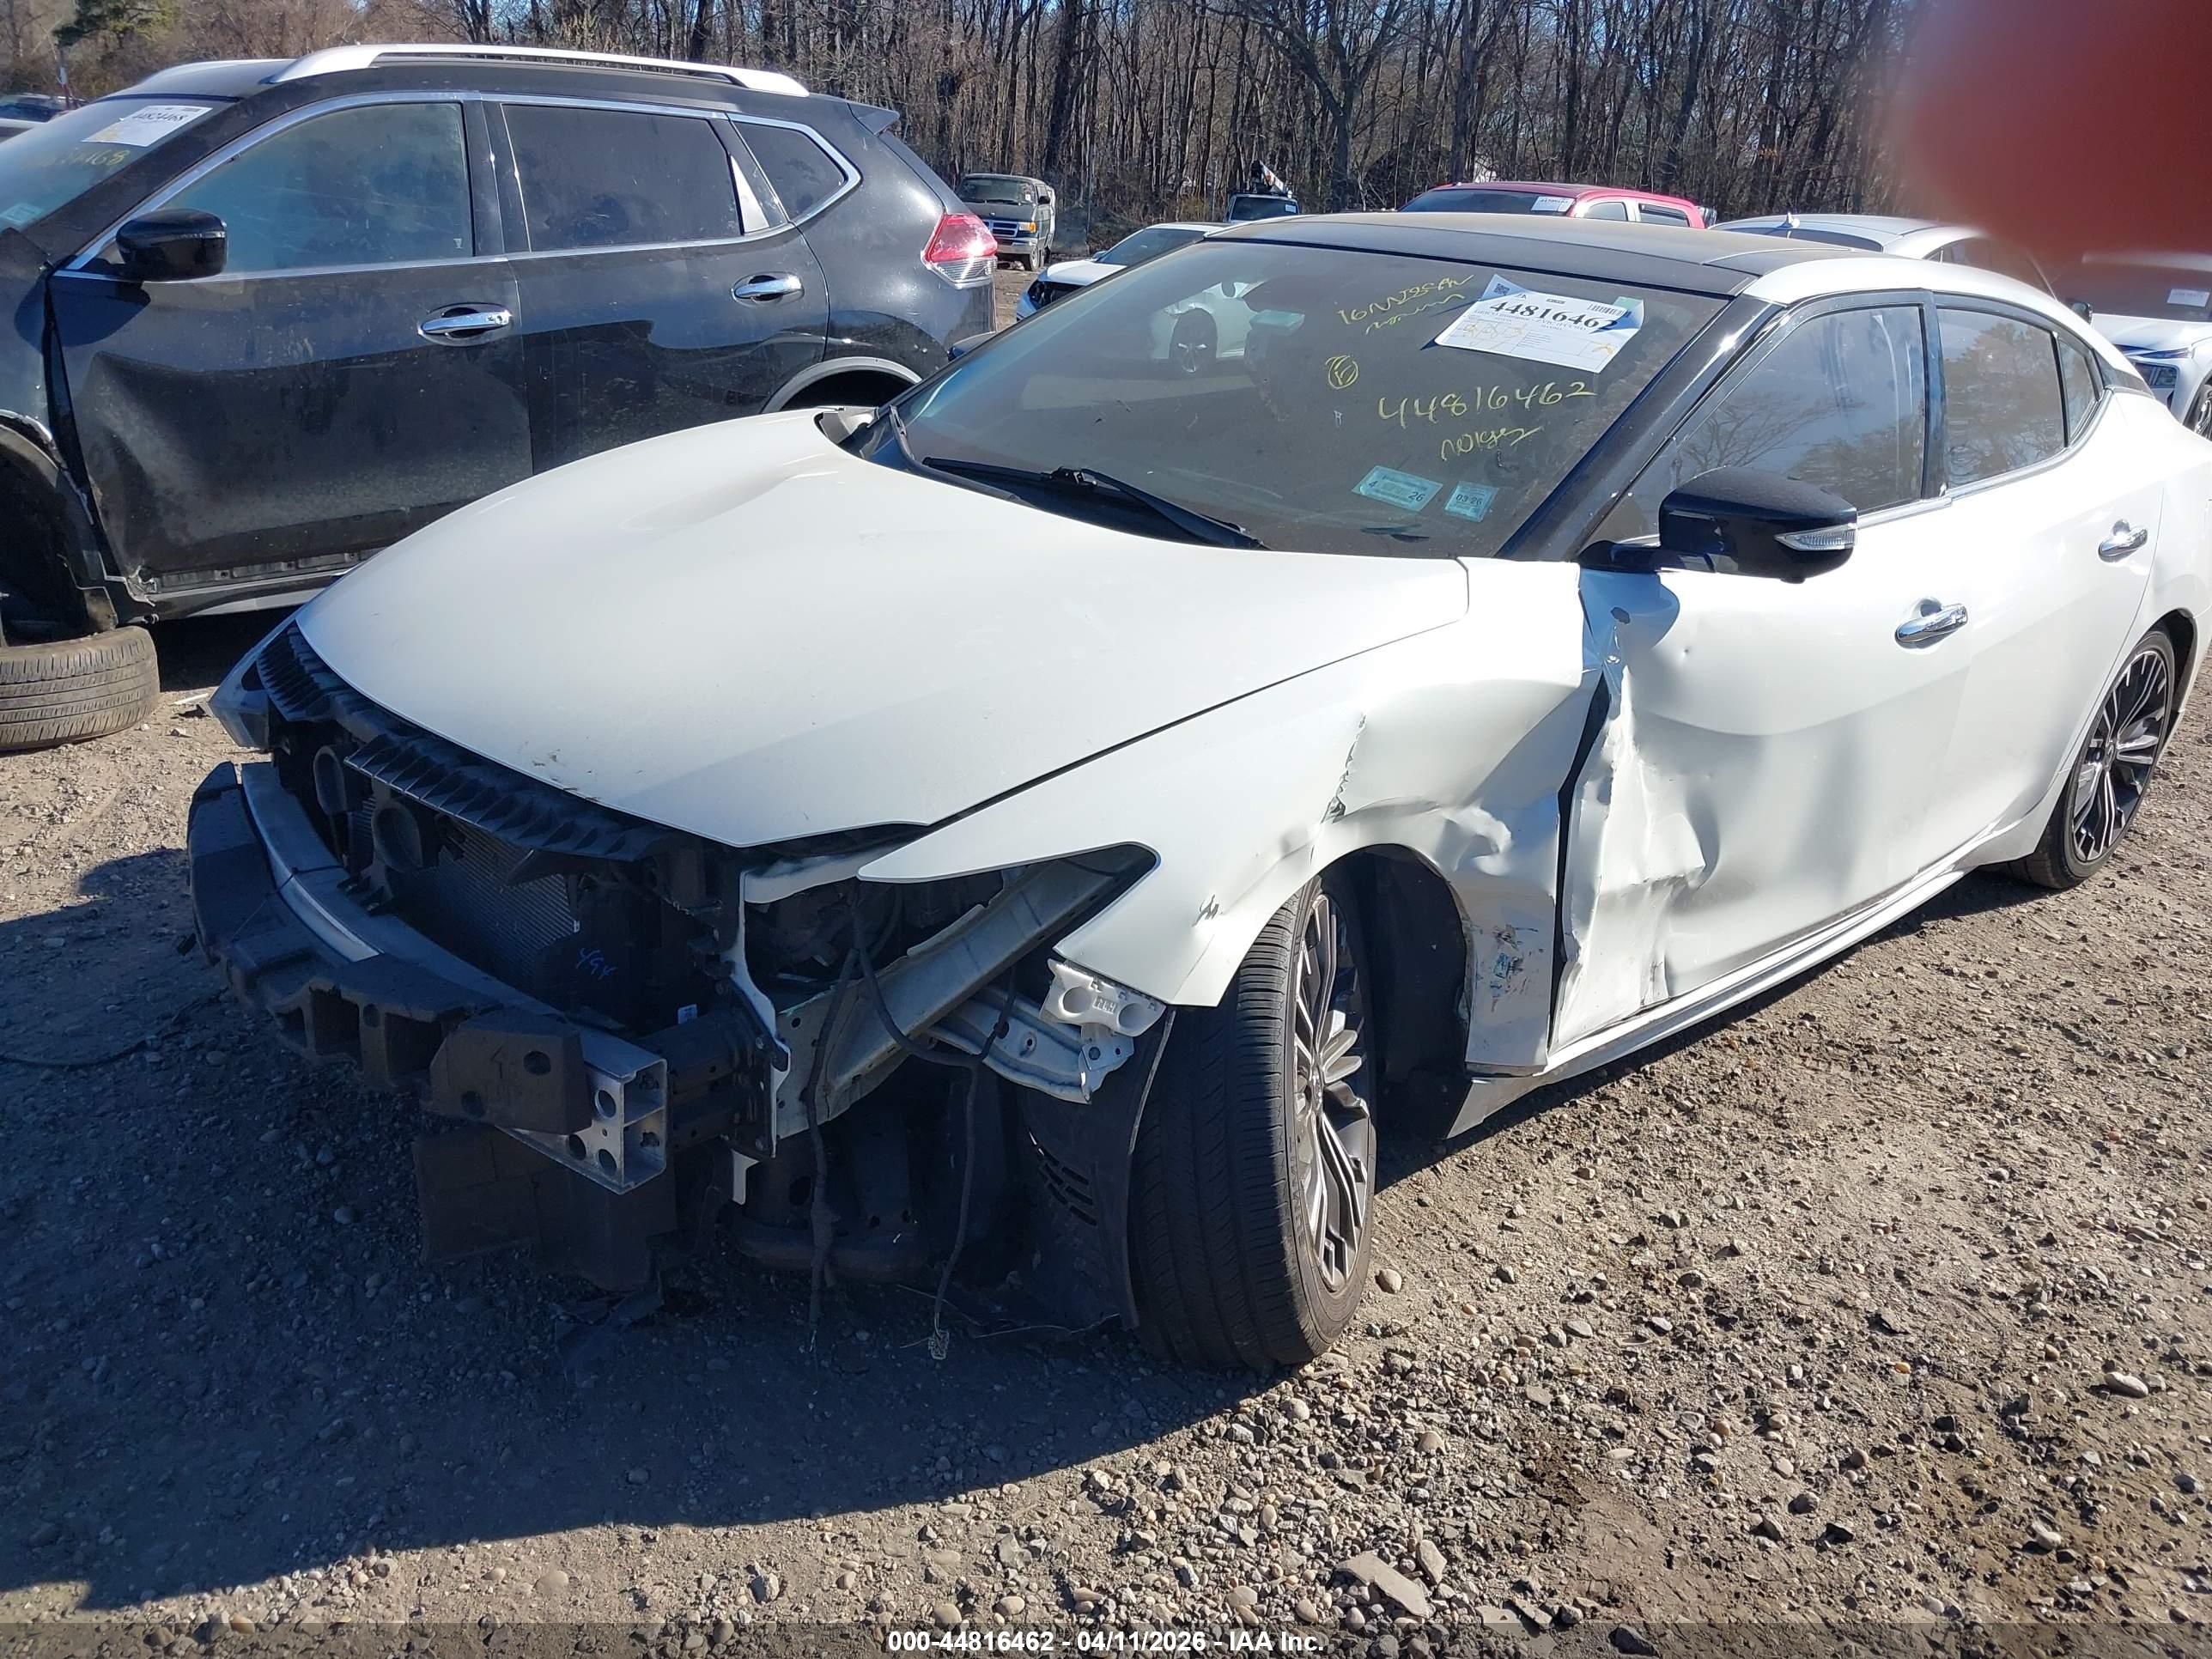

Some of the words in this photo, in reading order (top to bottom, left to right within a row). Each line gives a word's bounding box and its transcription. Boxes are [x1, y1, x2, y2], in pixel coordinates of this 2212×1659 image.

[1490, 301, 1618, 331] 44816462
[1377, 381, 1598, 429] 44816462
[1408, 491, 1425, 502] 26
